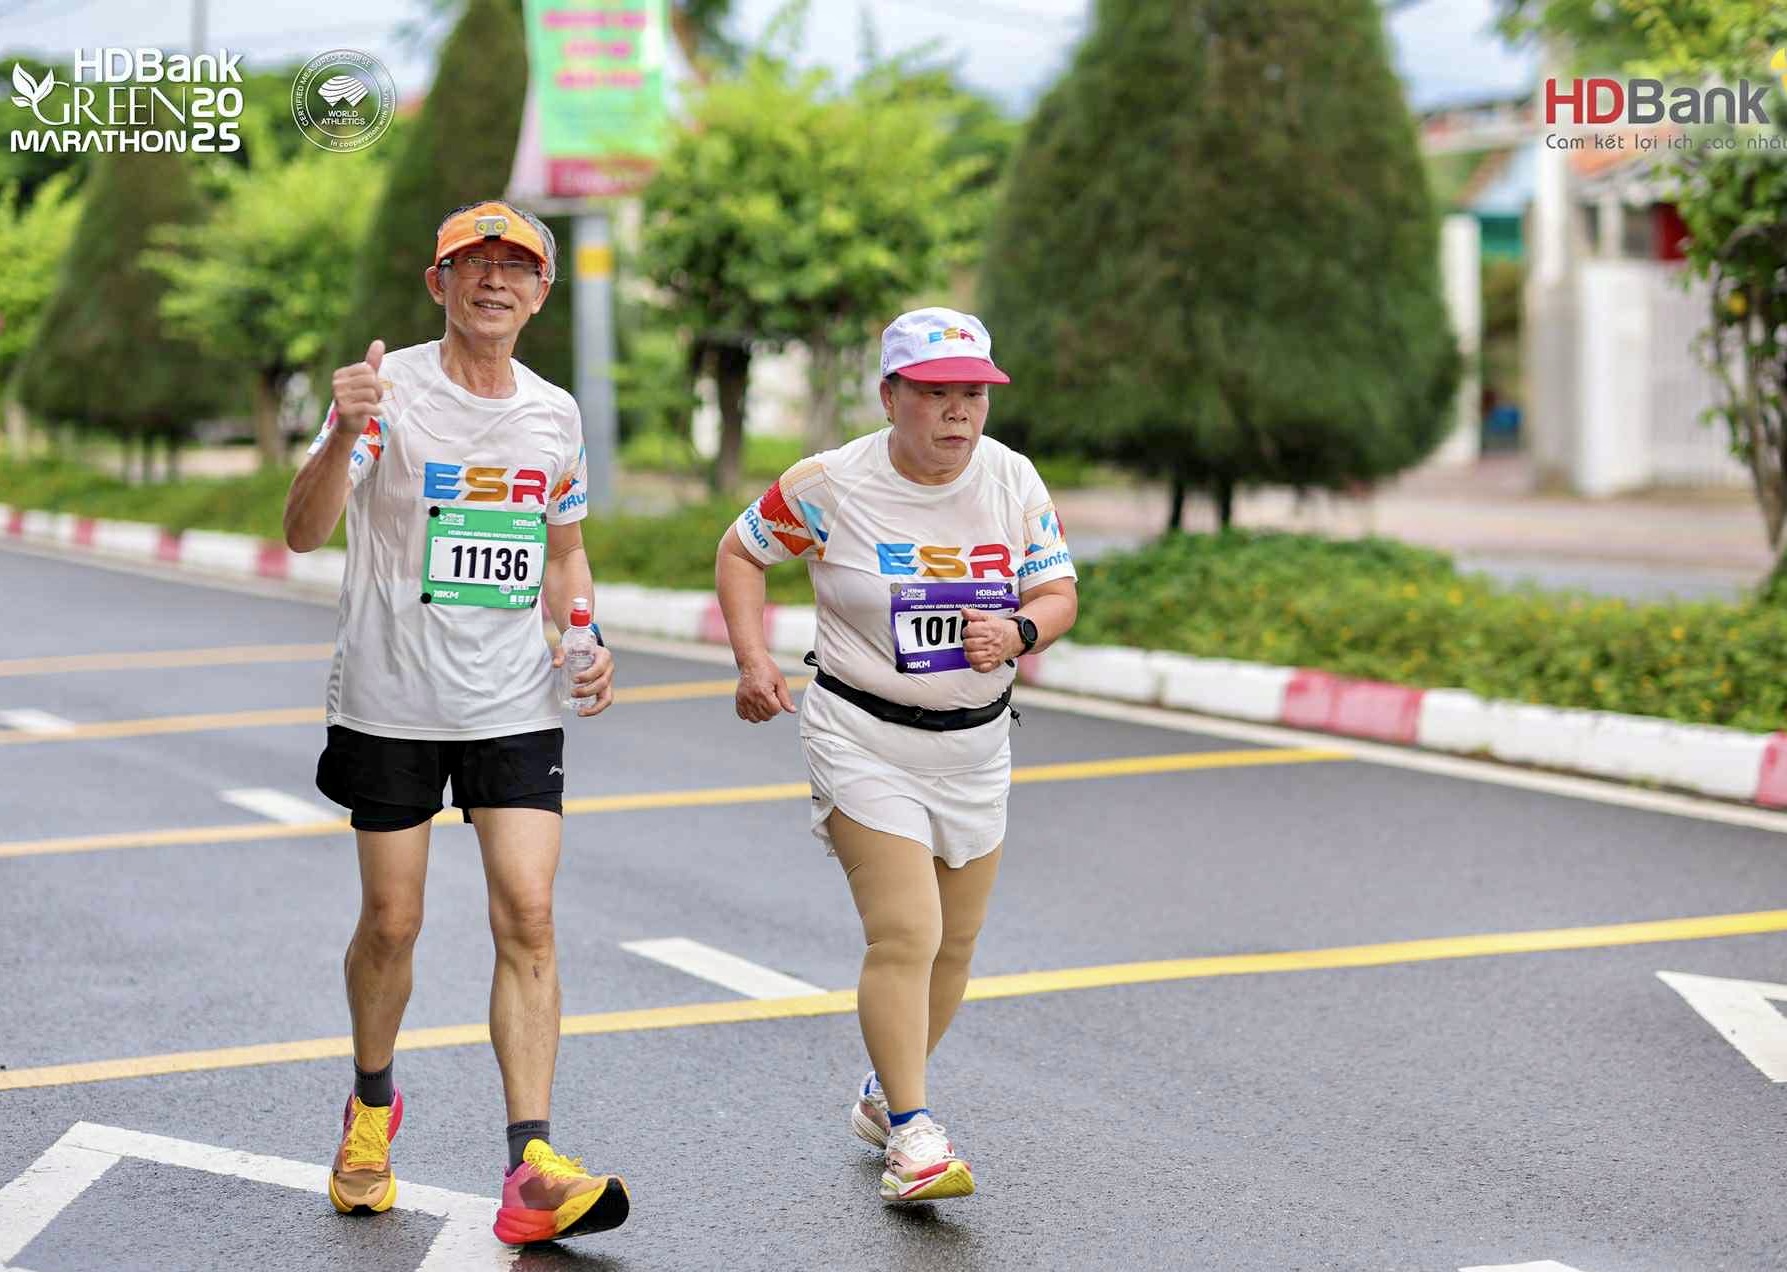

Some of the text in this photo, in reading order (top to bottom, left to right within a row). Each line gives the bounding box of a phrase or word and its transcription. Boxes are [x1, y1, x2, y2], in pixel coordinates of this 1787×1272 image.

[928, 327, 975, 344] ESR
[424, 462, 547, 504] ESR
[451, 545, 529, 581] 11136
[875, 543, 1015, 578] ESR
[911, 616, 967, 647] 101
